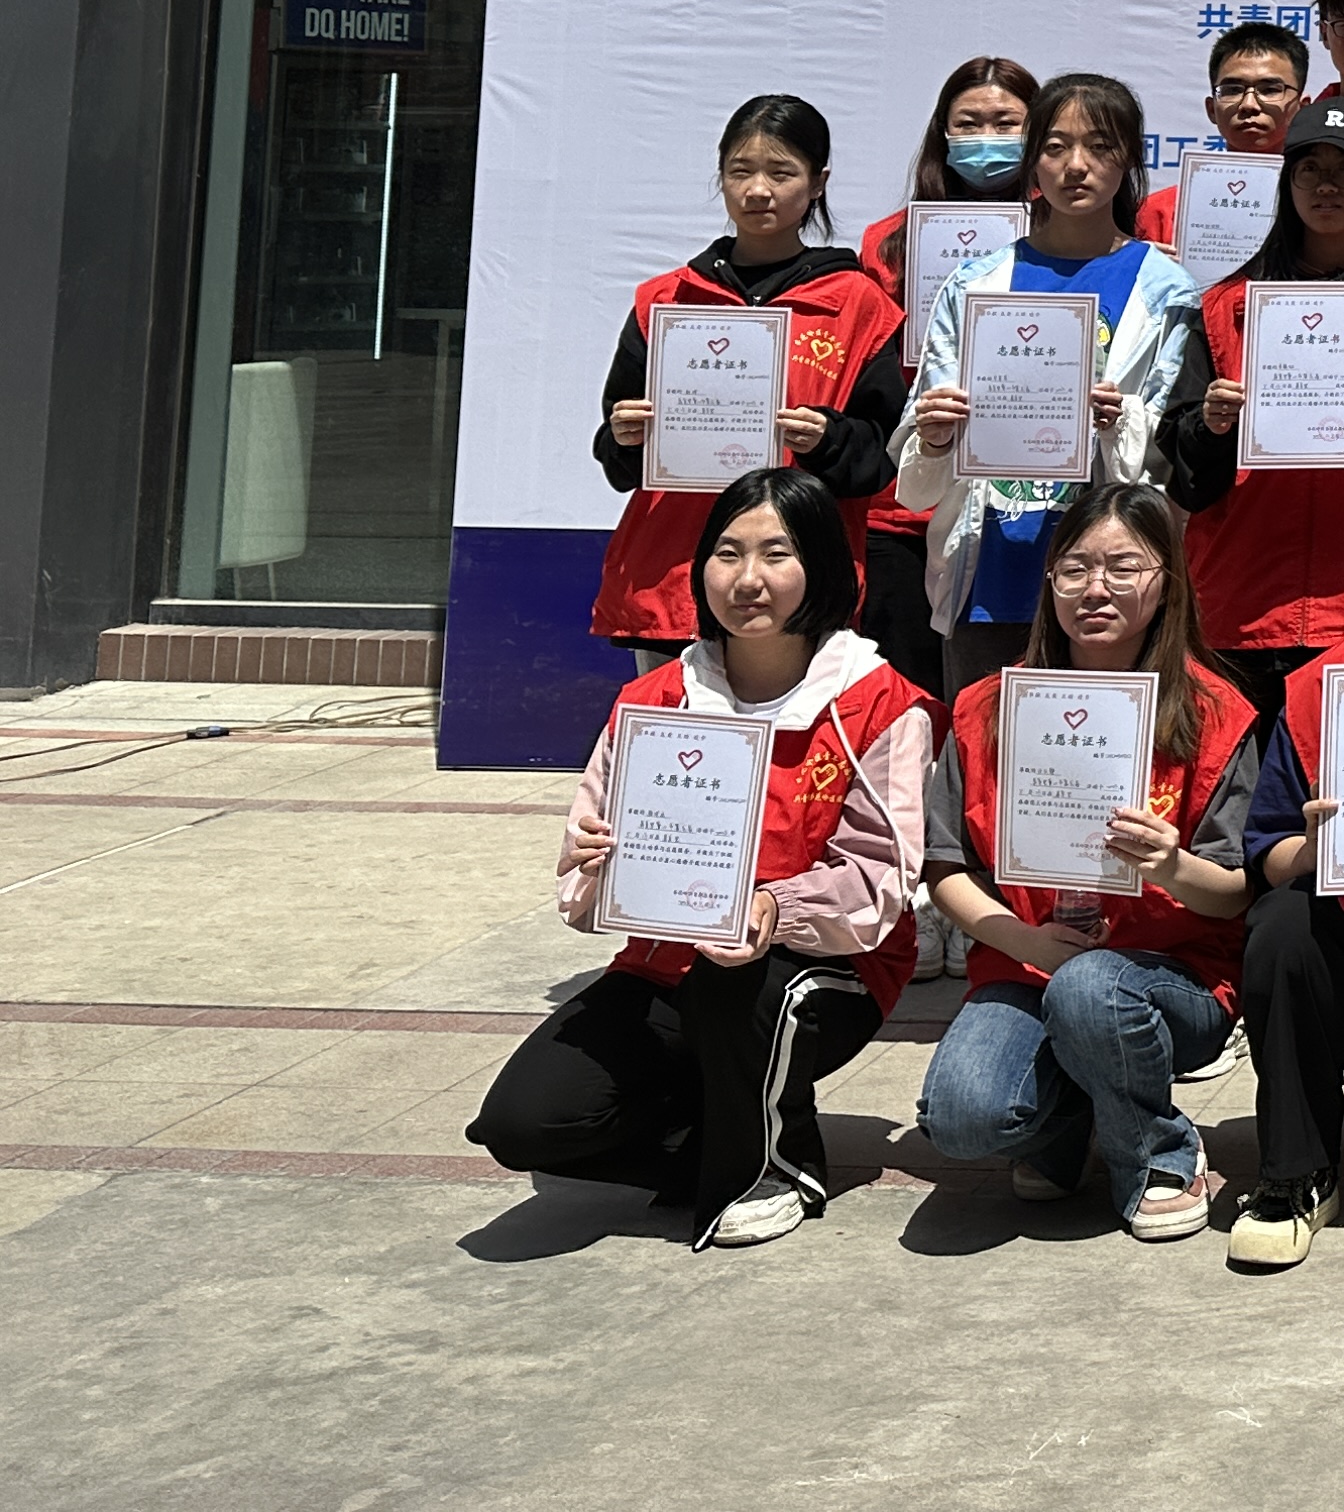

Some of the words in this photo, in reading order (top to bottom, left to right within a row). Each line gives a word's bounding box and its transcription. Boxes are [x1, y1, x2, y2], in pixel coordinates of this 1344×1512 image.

[305, 8, 335, 39] DQ
[340, 9, 409, 42] HOME!
[1325, 110, 1344, 128] R
[1281, 333, 1341, 345] 志愿者证书
[996, 344, 1058, 358] 志愿者证书
[686, 357, 749, 371] 志愿者证书
[1041, 732, 1108, 748] 志愿者证书
[653, 773, 722, 791] 志愿者证书
